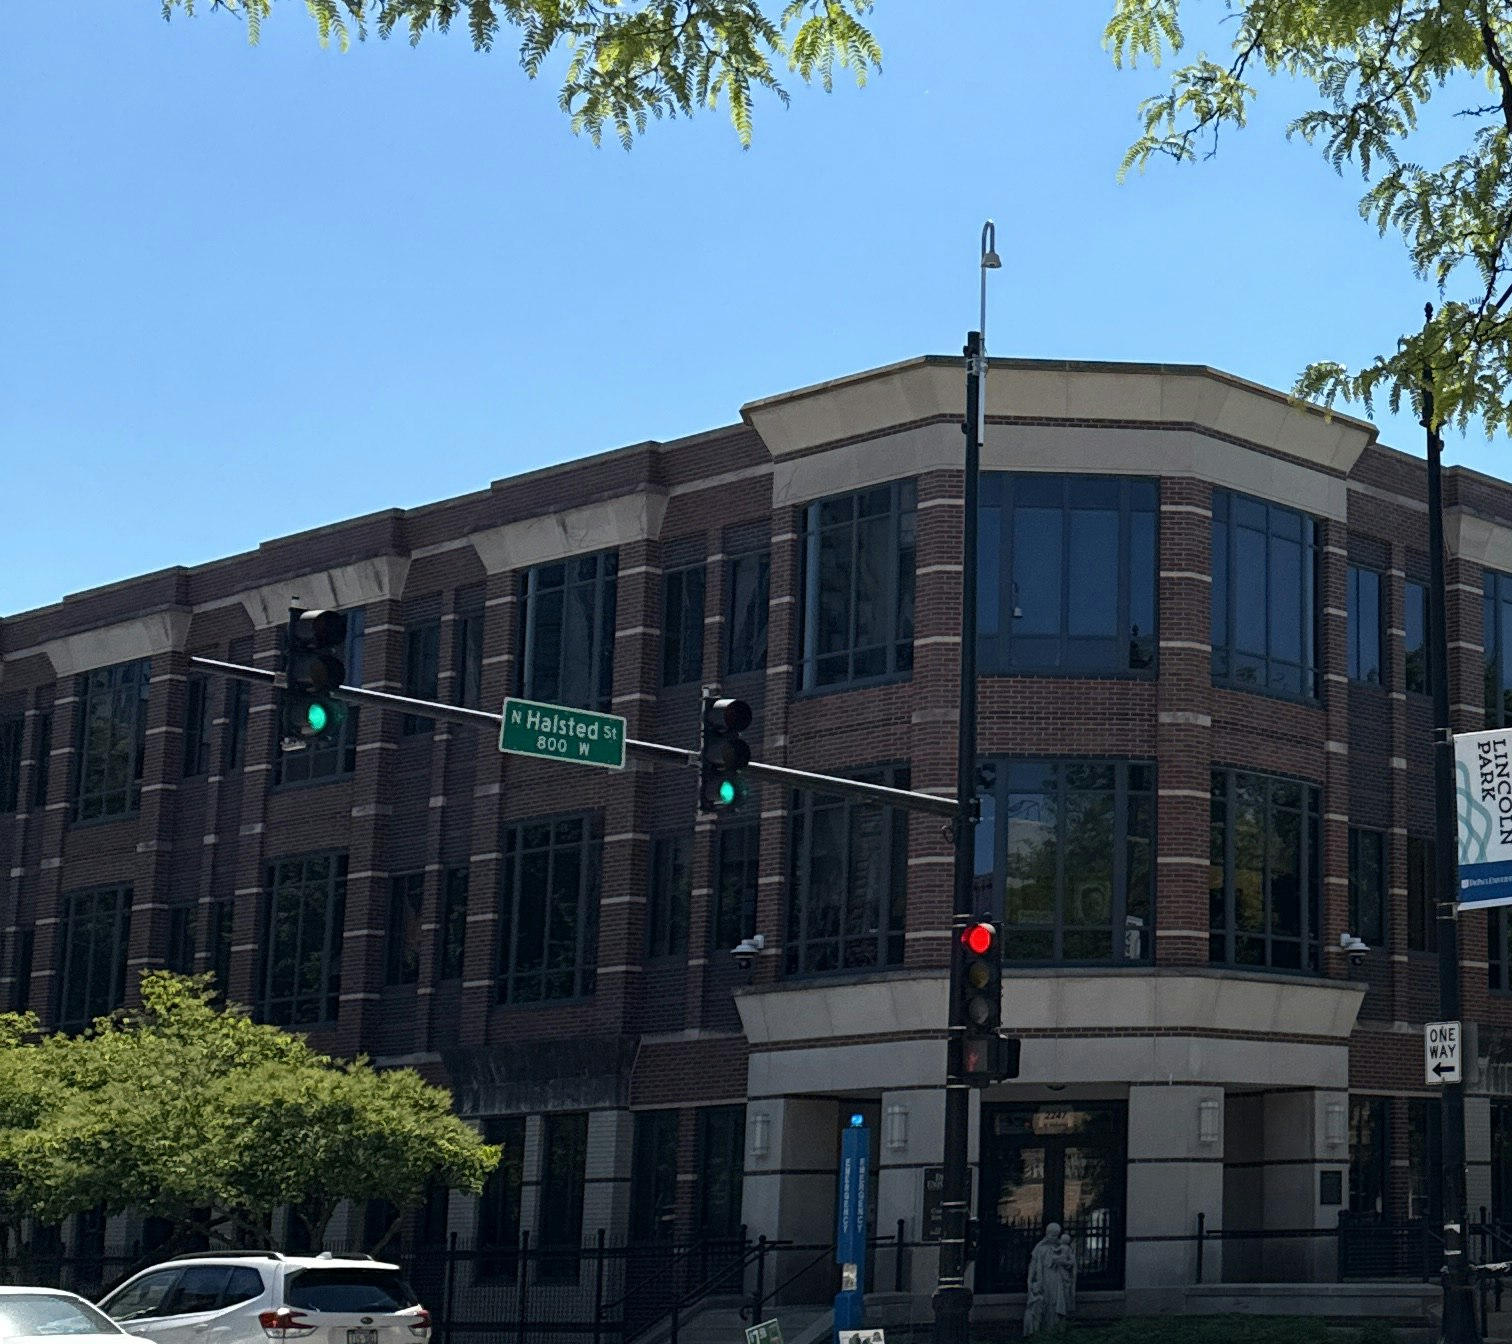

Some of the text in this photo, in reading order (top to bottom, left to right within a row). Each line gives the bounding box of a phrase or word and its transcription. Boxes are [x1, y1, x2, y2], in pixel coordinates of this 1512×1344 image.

[511, 709, 617, 740] N Halsted St
[536, 735, 590, 756] 800 W
[1477, 741, 1496, 802] PARK
[1429, 1027, 1456, 1043] ONE
[1429, 1044, 1457, 1059] WAY
